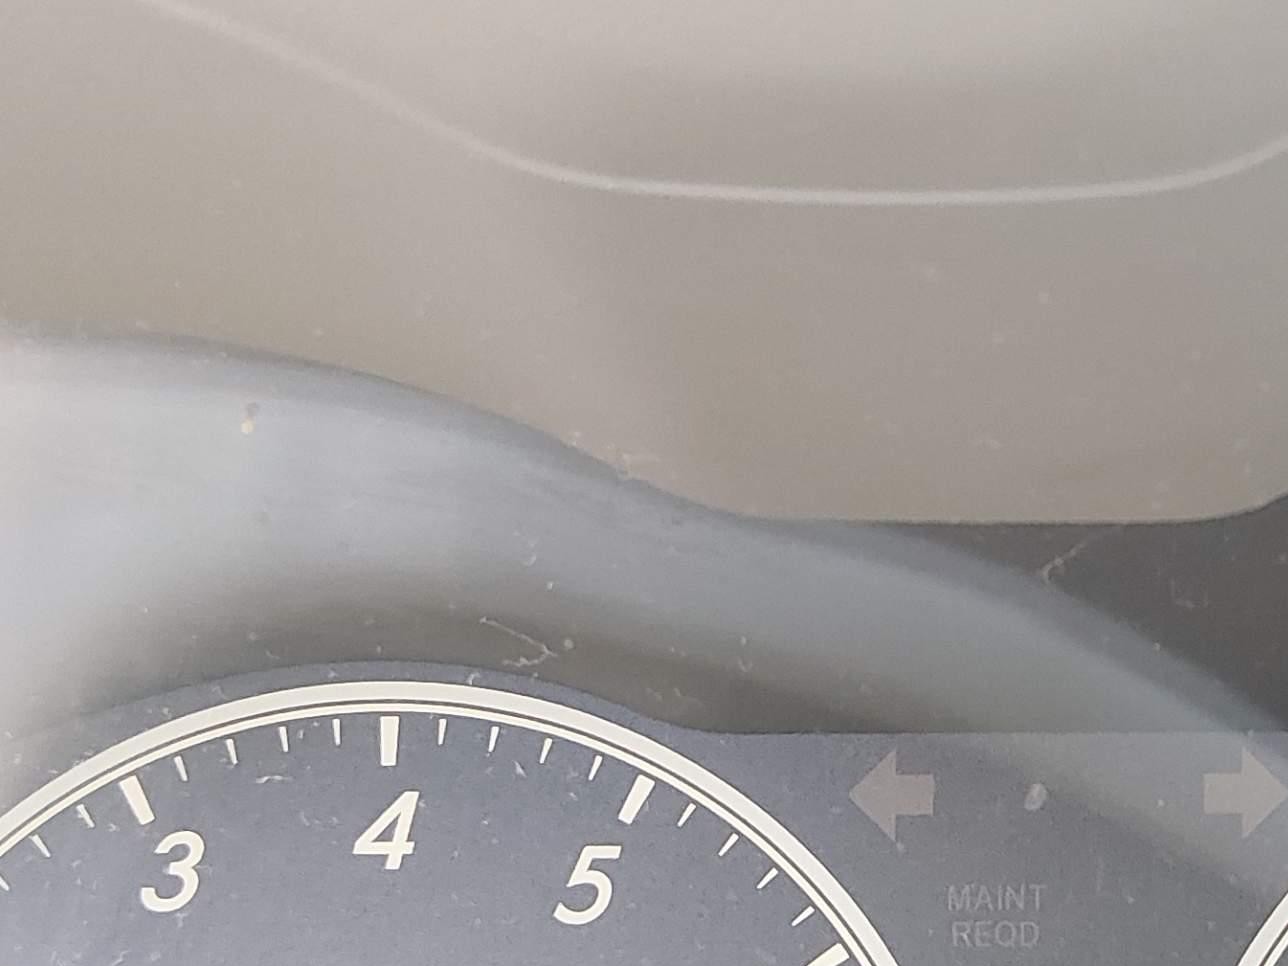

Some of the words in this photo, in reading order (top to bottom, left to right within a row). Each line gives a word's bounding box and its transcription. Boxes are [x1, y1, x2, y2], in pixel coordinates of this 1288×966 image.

[353, 792, 419, 869] 4
[141, 831, 204, 912] 3
[554, 846, 621, 924] 5
[945, 884, 1047, 912] MAINT
[951, 920, 1040, 948] REQD
